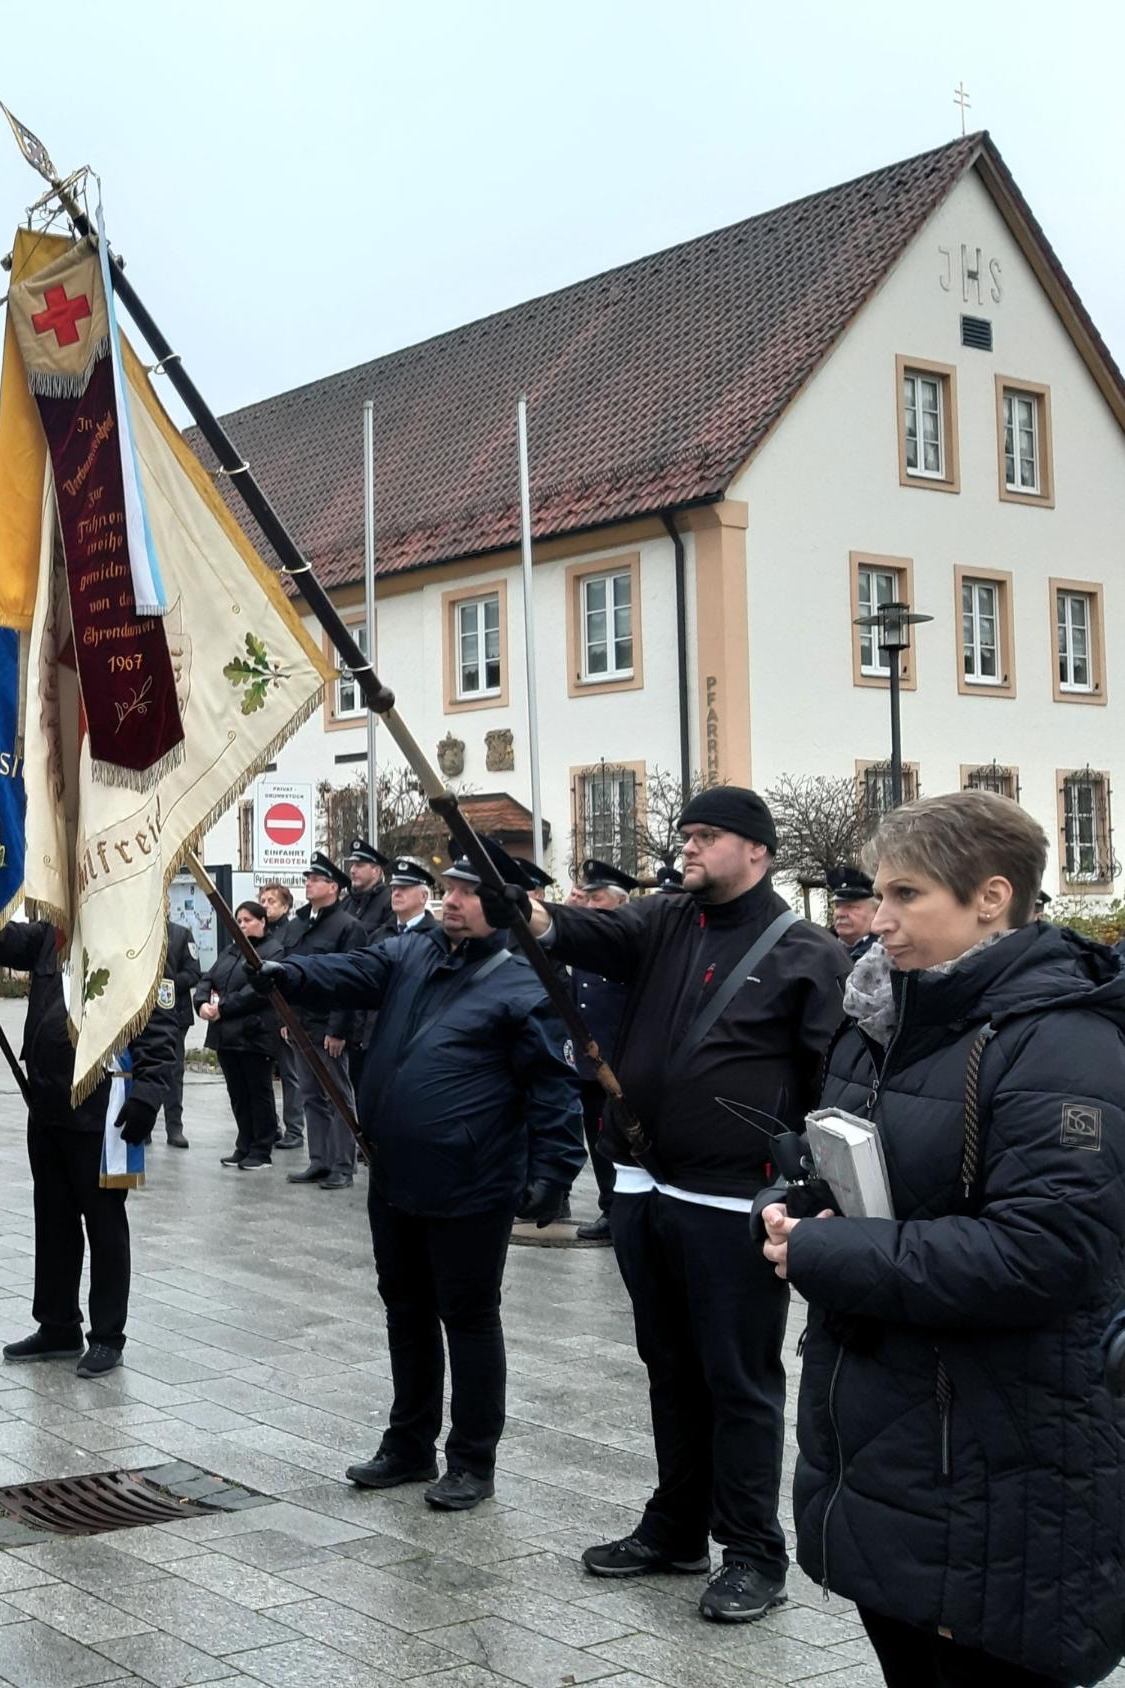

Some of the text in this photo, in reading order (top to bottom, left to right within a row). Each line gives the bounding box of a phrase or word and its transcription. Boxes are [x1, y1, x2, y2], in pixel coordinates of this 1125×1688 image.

[77, 418, 93, 432] In
[88, 486, 104, 508] zur
[78, 512, 123, 544] Fahnen
[87, 531, 123, 556] weihe
[80, 561, 132, 592] gewidm
[89, 597, 110, 613] von
[107, 653, 143, 673] 1967
[706, 676, 719, 786] PFARRHE
[263, 857, 308, 865] VERBOTEN
[264, 849, 305, 857] EINFAHRT
